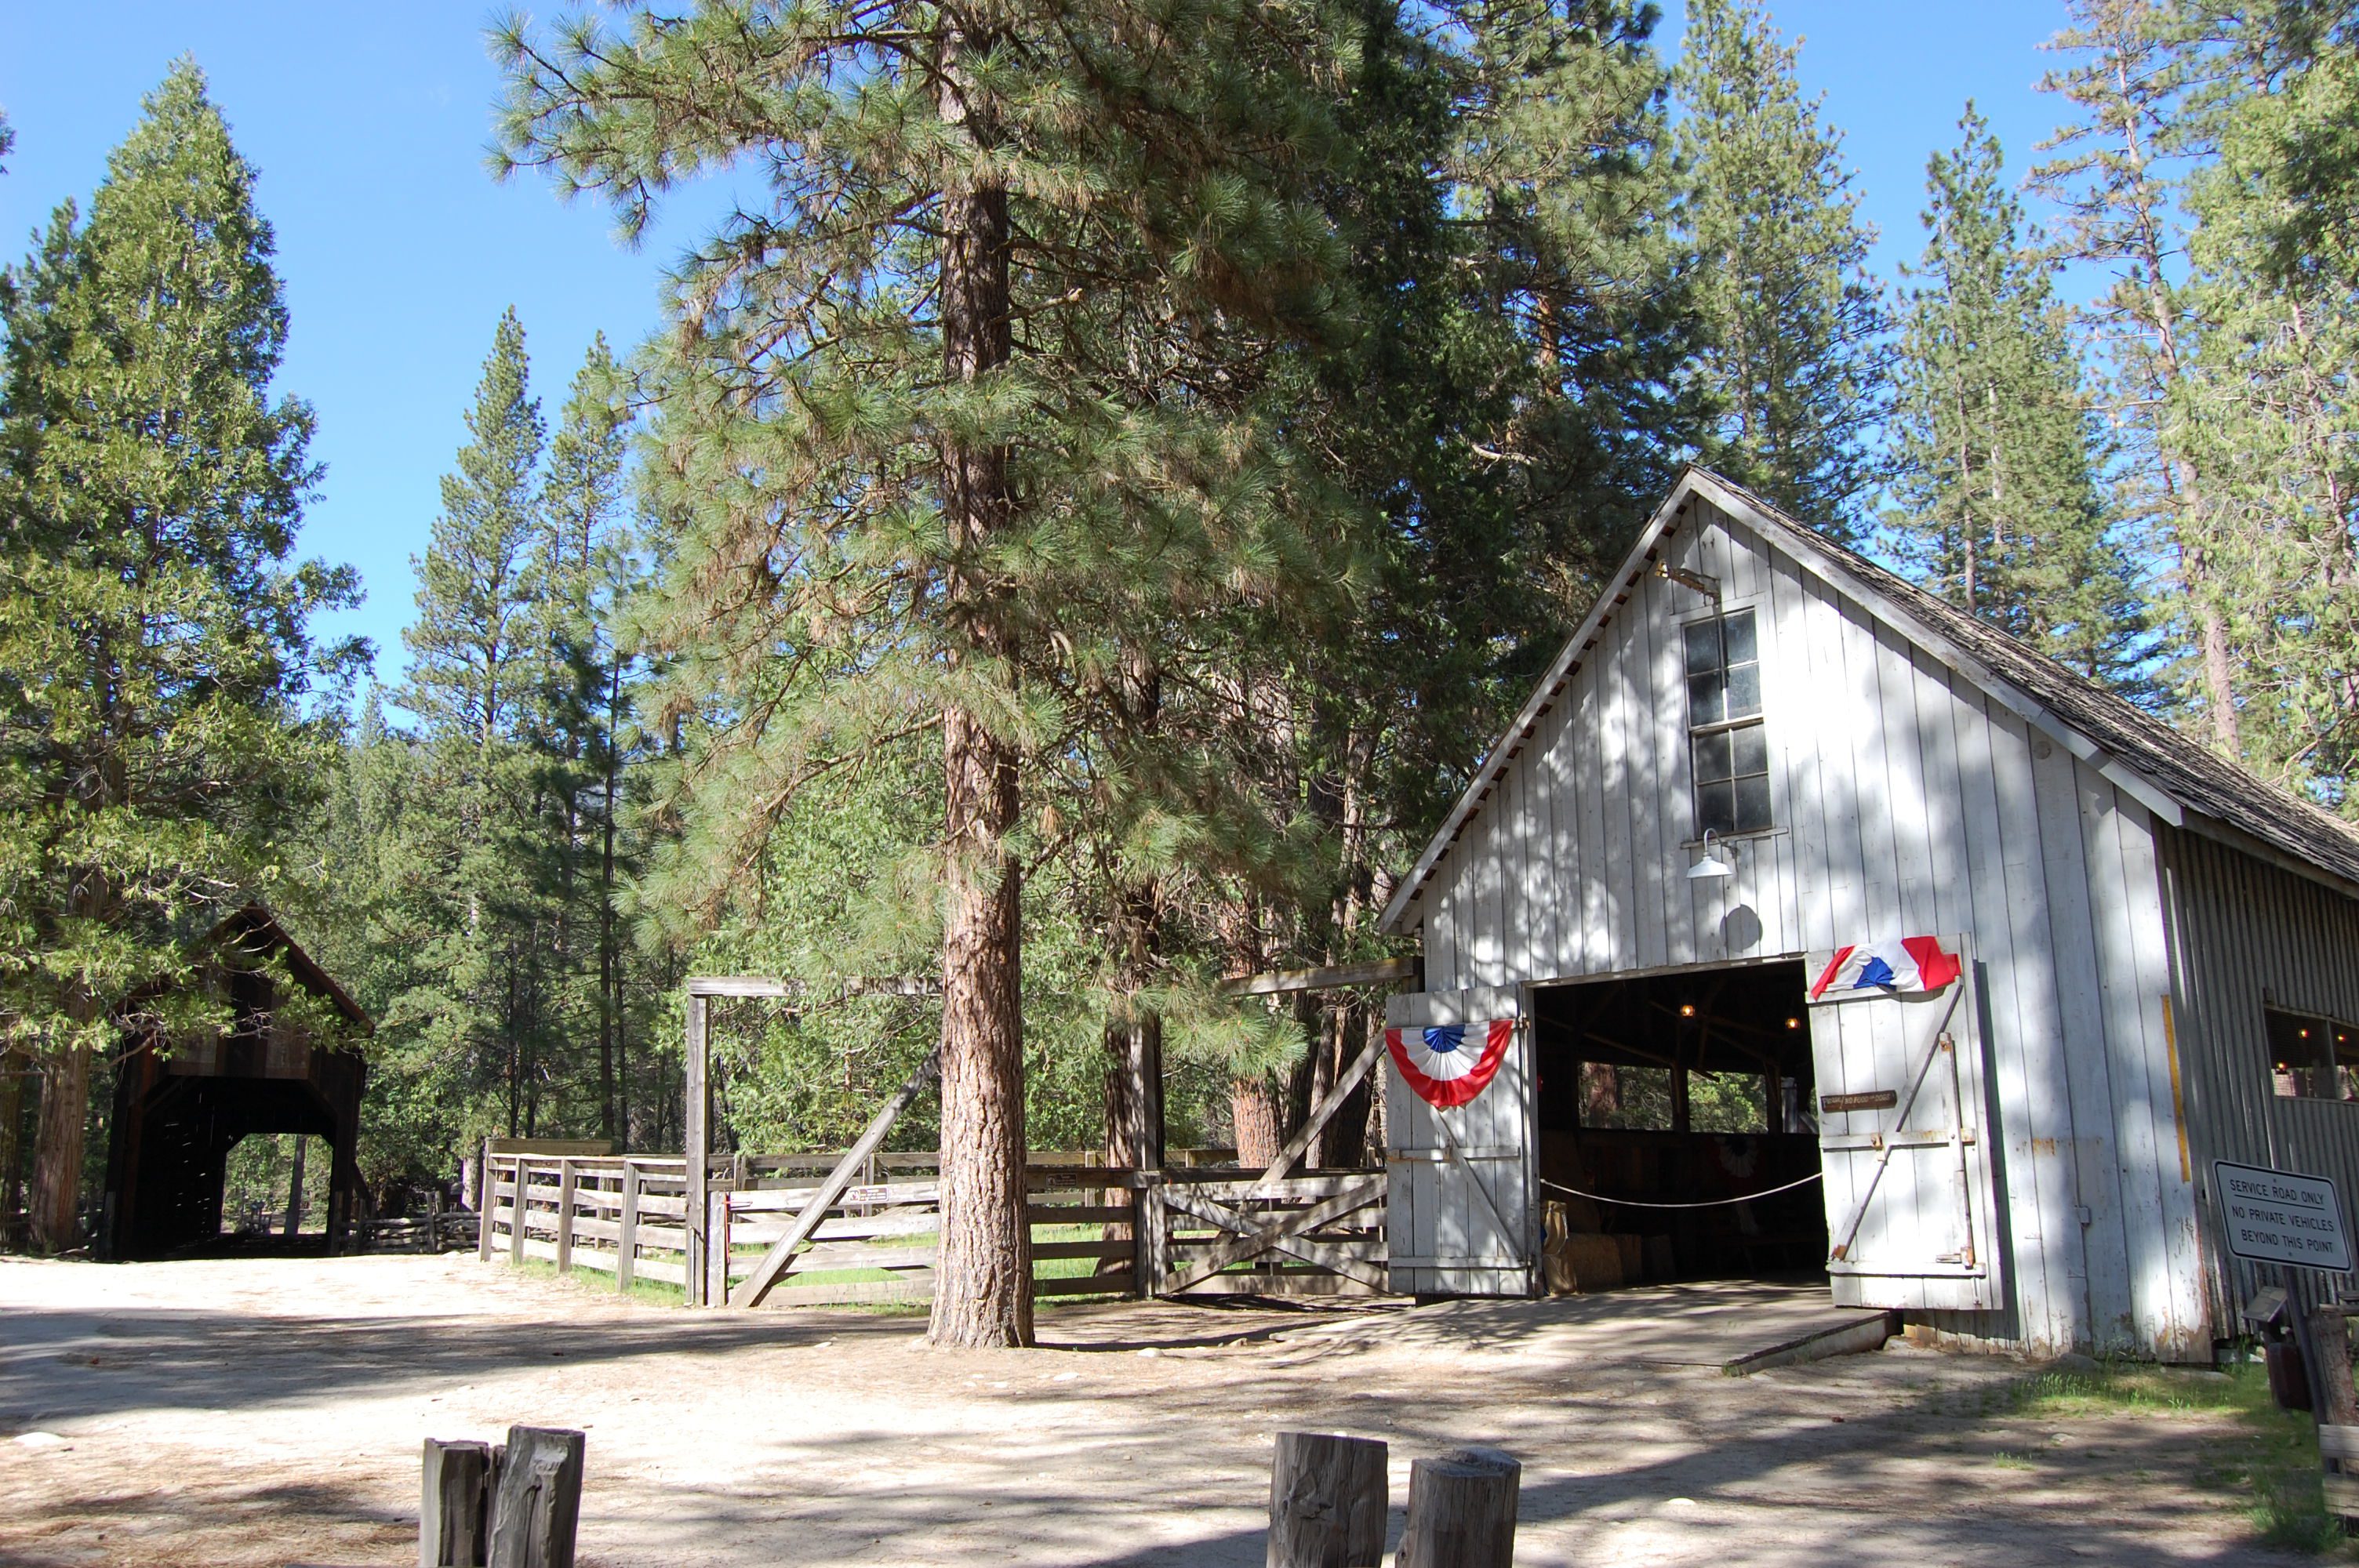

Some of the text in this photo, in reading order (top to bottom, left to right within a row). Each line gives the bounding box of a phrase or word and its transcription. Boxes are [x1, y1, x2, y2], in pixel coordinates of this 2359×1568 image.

[2230, 1179, 2324, 1204] SERVICE ROAD ONLY
[2232, 1205, 2334, 1232] NO PRIVATE VEHICLES
[2241, 1229, 2333, 1253] BEYOND THIS POINT
